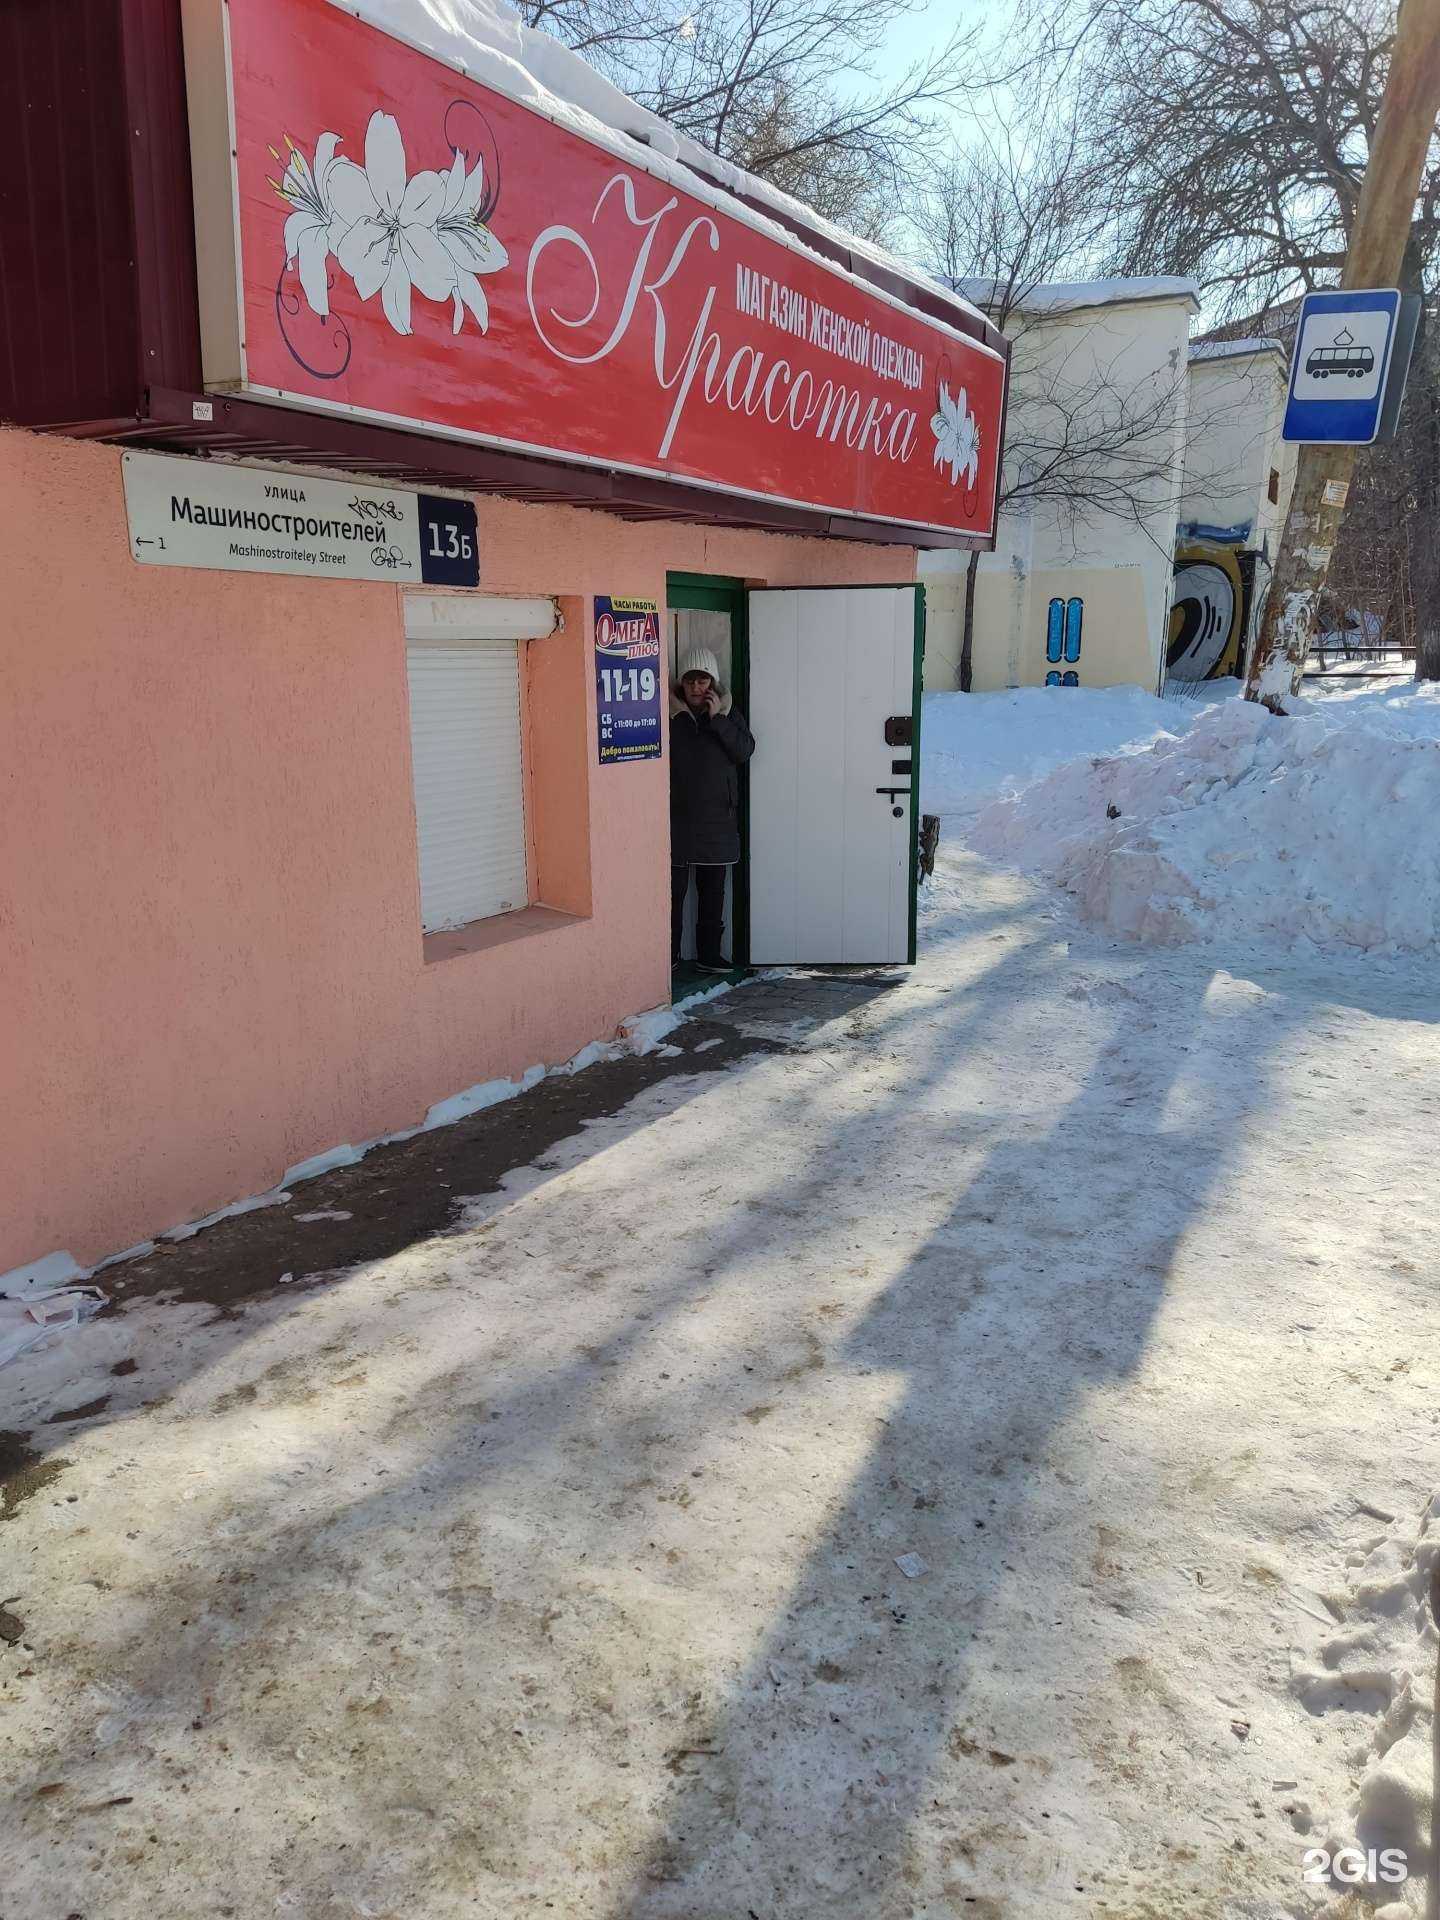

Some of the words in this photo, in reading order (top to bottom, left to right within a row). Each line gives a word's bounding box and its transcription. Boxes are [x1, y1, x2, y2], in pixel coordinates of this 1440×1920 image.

[527, 173, 919, 463] Красотка
[736, 263, 808, 340] МАГАЗИН
[808, 301, 870, 368] ЖЕНСКОЙ
[872, 332, 924, 391] ОДЕЖДЫ
[264, 485, 306, 502] УЛИЦА
[171, 495, 386, 543] Машиностроителей
[158, 537, 167, 550] 1
[229, 543, 317, 563] Mashinostroiteley
[319, 551, 346, 565] Street
[614, 600, 631, 609] ЧАСЫ
[632, 601, 656, 610] РАБОТЫ
[601, 668, 655, 702] 11-19
[601, 713, 612, 725] СБ
[601, 727, 613, 739] ВС
[601, 746, 621, 757] Добро
